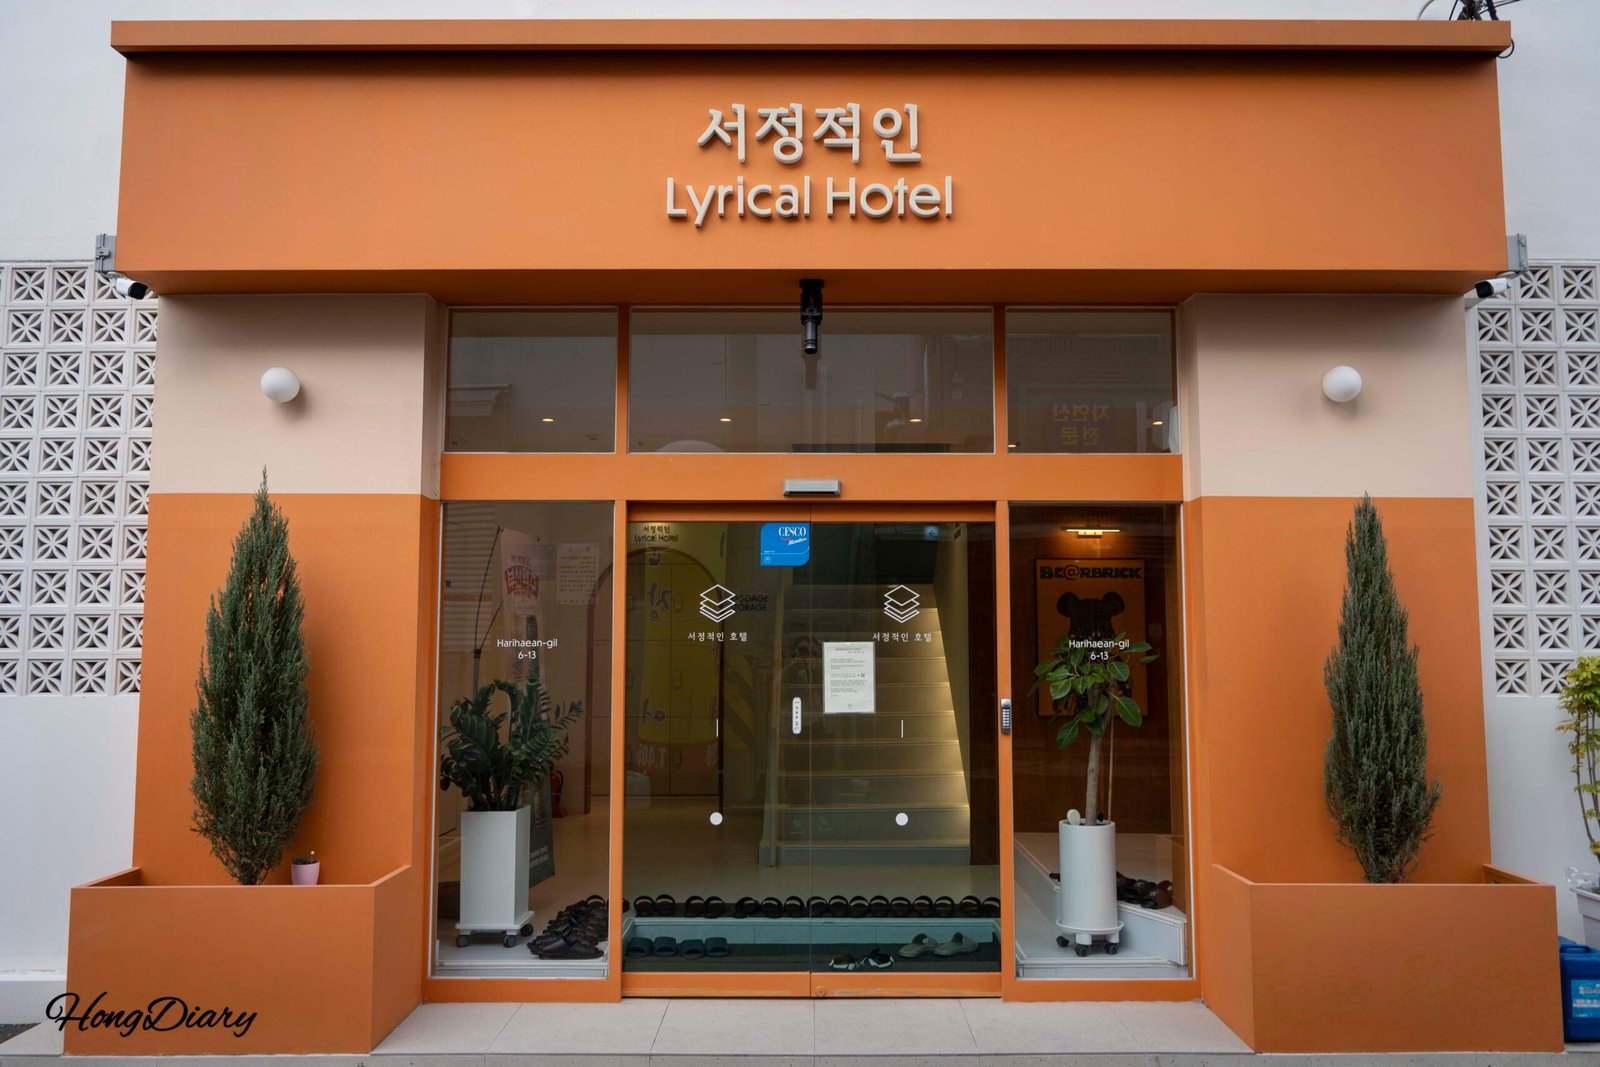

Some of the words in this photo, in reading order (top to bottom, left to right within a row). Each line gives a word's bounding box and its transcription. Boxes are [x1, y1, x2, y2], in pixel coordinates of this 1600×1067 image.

[697, 102, 922, 164] 서정적인
[666, 175, 811, 228] Lyrical
[826, 175, 953, 219] Hotel
[778, 526, 807, 537] CESCO
[1039, 564, 1142, 580] BE@RBRICK
[687, 632, 724, 642] 서정적인
[729, 632, 748, 642] 호텔
[872, 632, 909, 642] 서정적인
[914, 632, 932, 642] 호텔
[496, 638, 558, 650] Harihaean-gil
[1068, 639, 1130, 650] Harihaean-gil
[517, 650, 537, 660] 6-13
[1090, 651, 1109, 660] 6-13
